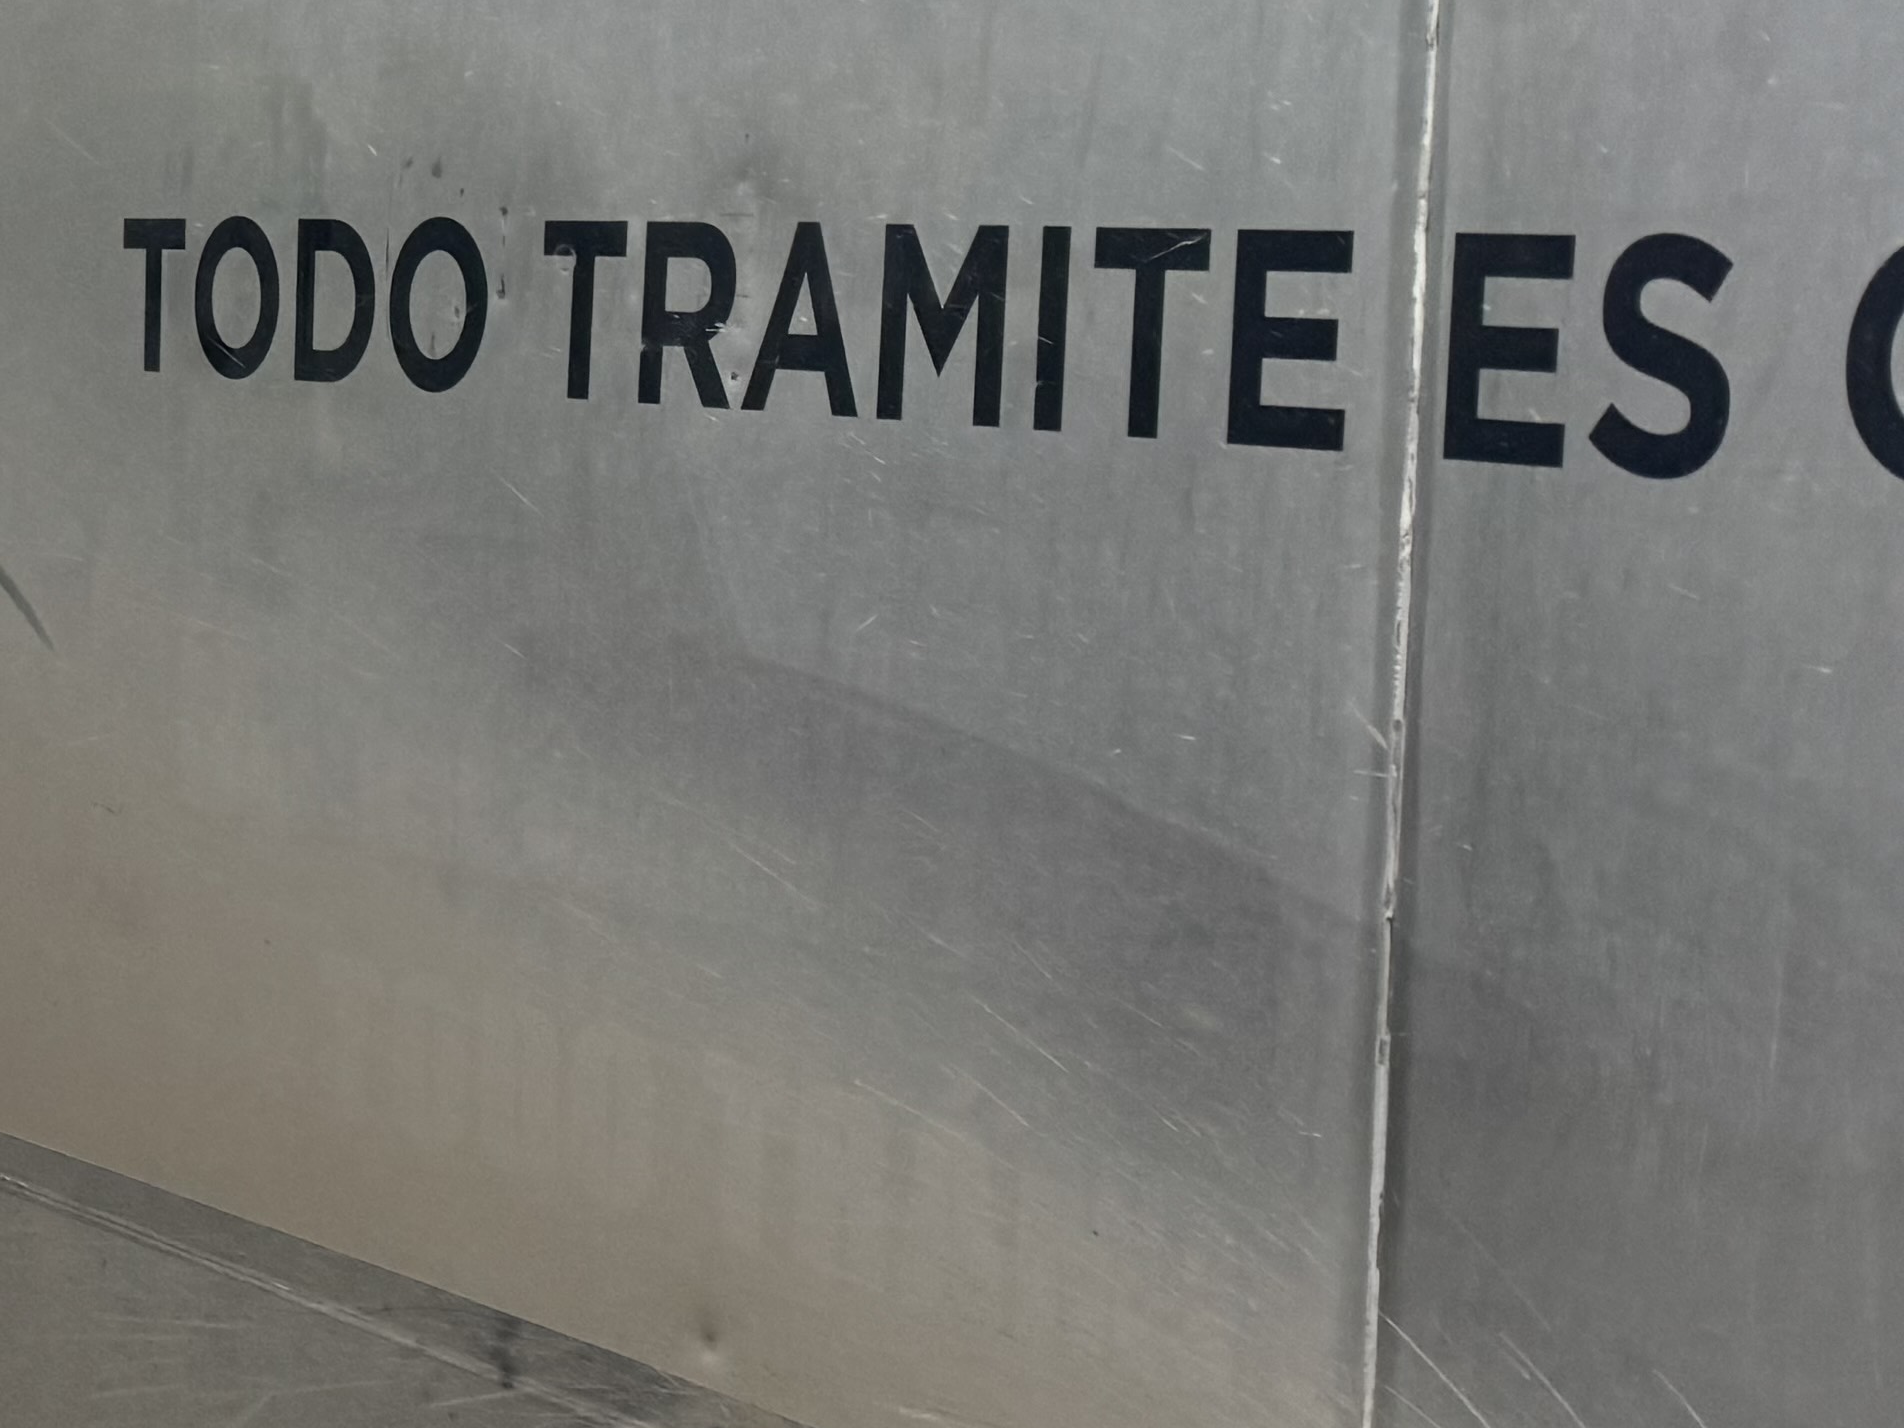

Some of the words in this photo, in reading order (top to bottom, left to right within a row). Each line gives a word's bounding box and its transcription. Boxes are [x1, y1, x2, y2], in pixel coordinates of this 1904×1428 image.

[122, 215, 489, 394] TODO
[543, 219, 1356, 453] TRAMITE
[1442, 231, 1734, 480] ES
